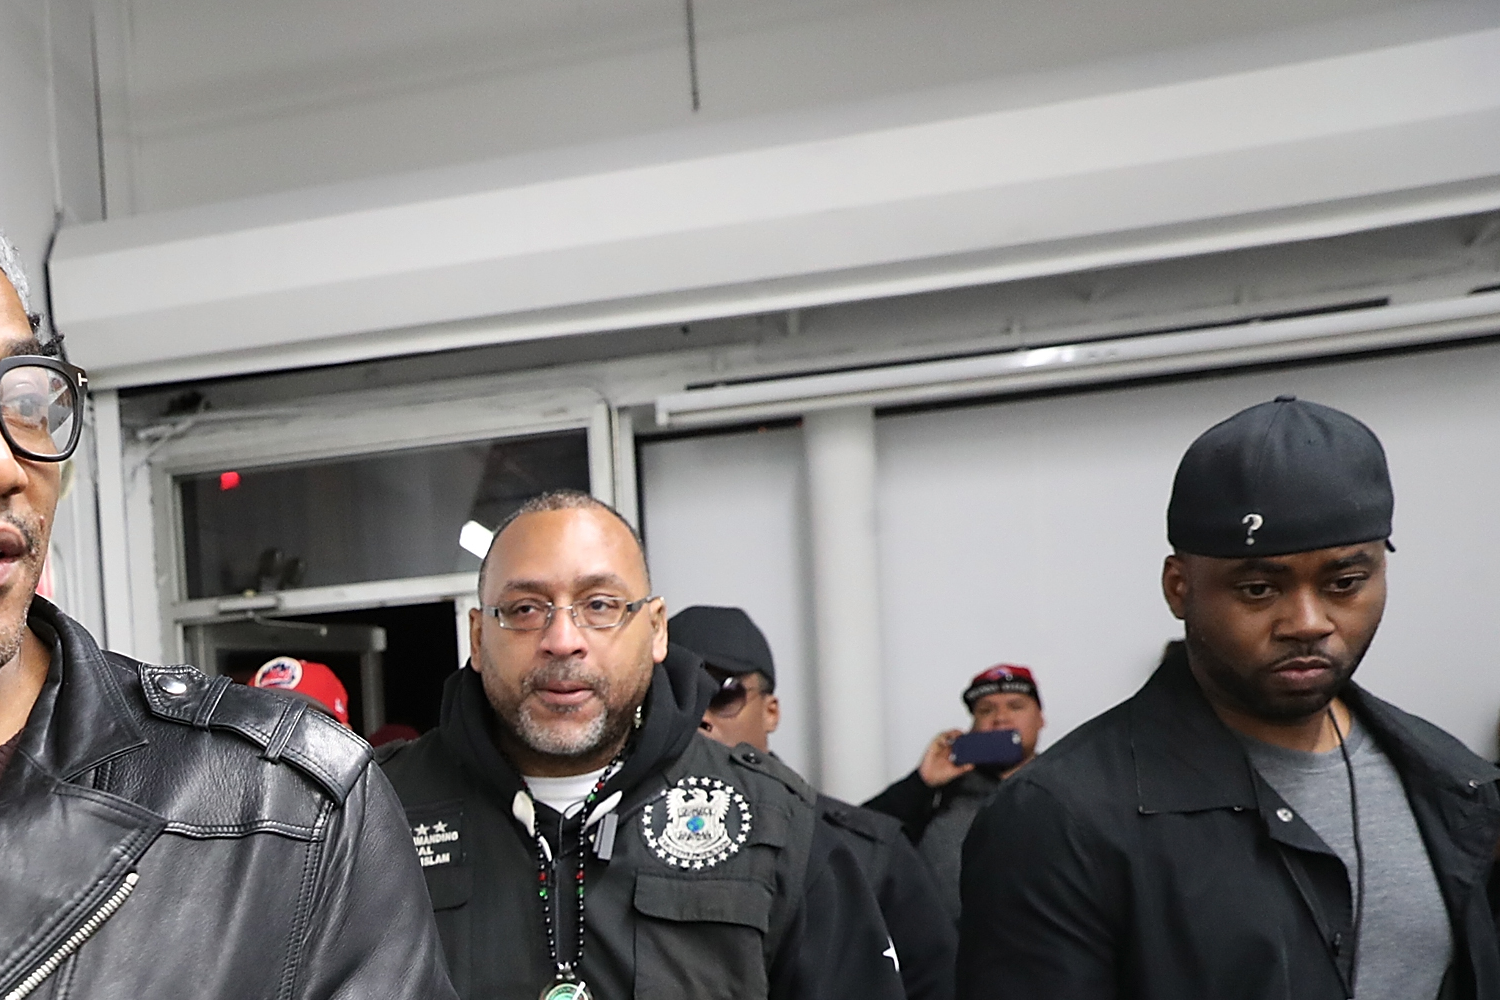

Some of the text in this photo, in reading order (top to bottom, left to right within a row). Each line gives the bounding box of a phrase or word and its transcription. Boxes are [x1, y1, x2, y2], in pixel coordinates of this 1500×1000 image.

[1242, 513, 1264, 545] ?
[415, 845, 434, 856] AL
[420, 852, 451, 867] ISLAM
